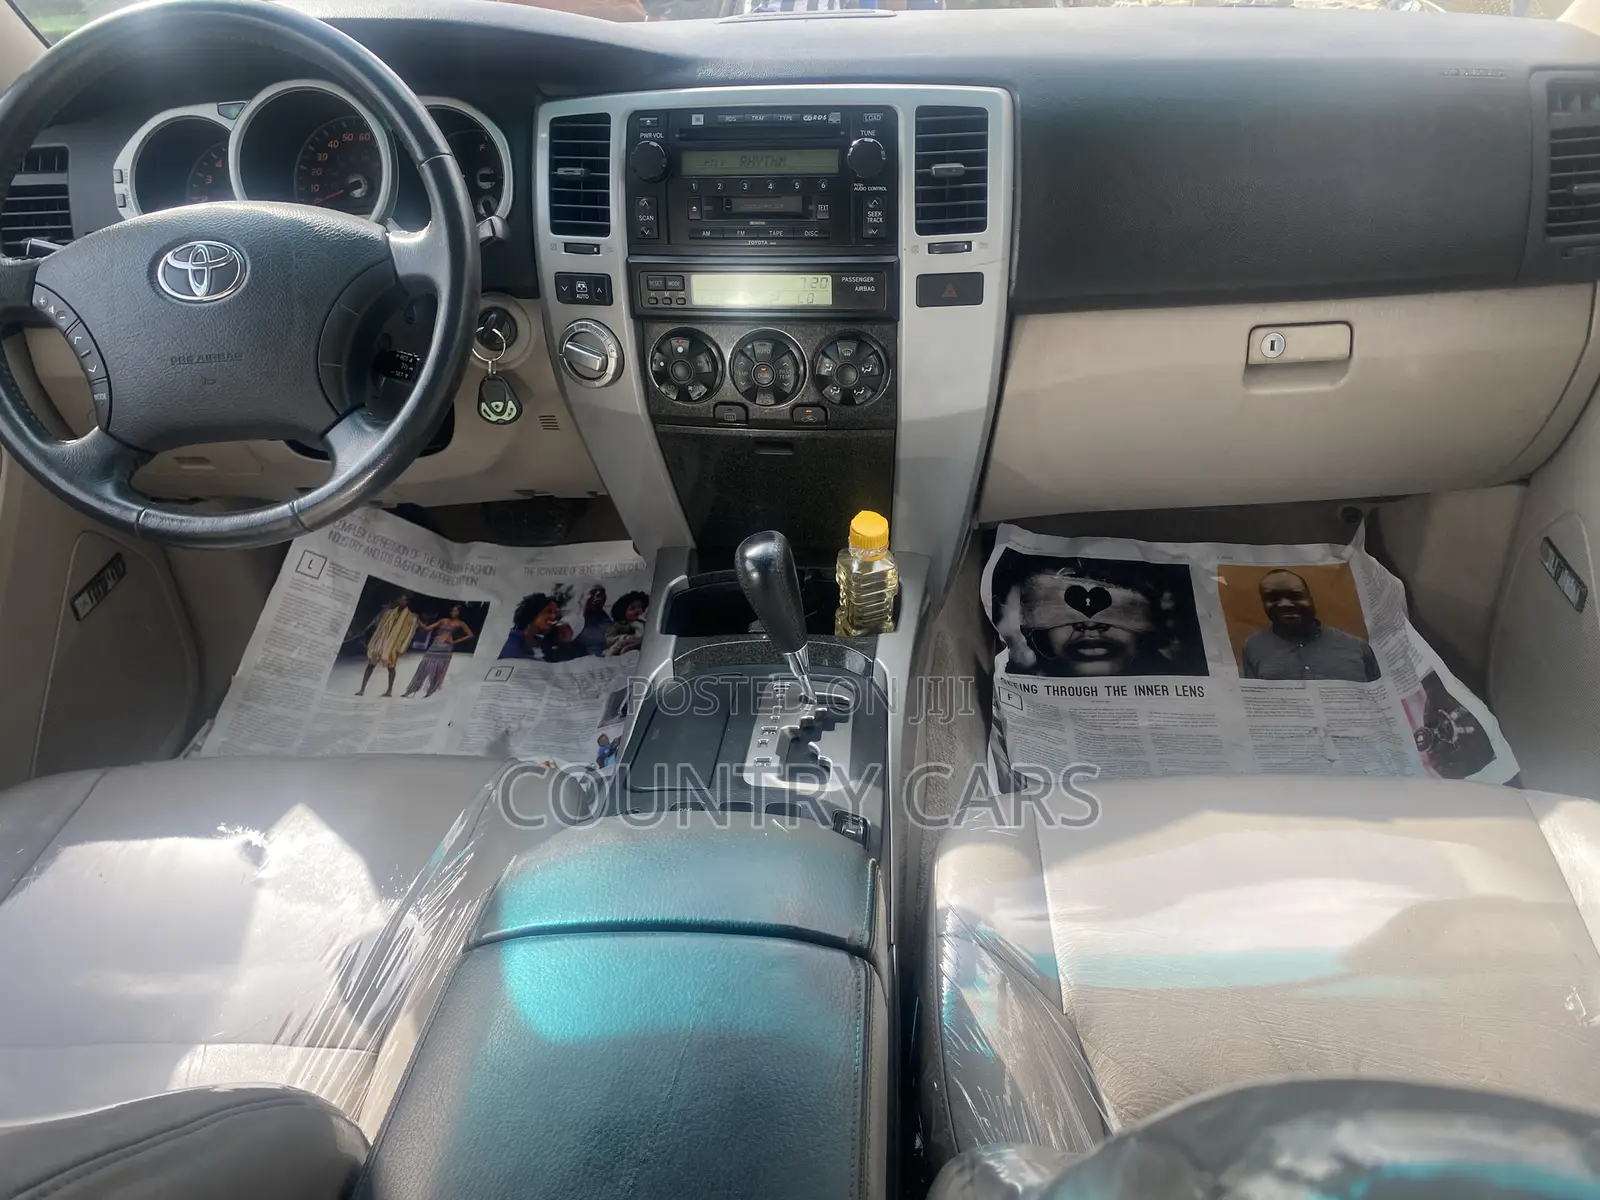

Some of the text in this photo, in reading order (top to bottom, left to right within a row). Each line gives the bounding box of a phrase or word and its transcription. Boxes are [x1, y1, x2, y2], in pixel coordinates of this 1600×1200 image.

[342, 133, 354, 142] 50
[358, 133, 371, 141] 60
[327, 140, 340, 148] 40
[739, 155, 787, 168] RHYTHM
[311, 184, 320, 192] 10
[328, 530, 364, 553] INDUSTRY
[363, 544, 379, 560] AND
[367, 531, 408, 555] EXPRESSION
[423, 552, 437, 567] THE
[464, 561, 497, 576] FASHION
[524, 566, 535, 577] THE
[1044, 685, 1099, 697] THROUGH
[1104, 685, 1128, 697] THE
[1134, 684, 1170, 697] INNER
[1175, 684, 1205, 698] LENS
